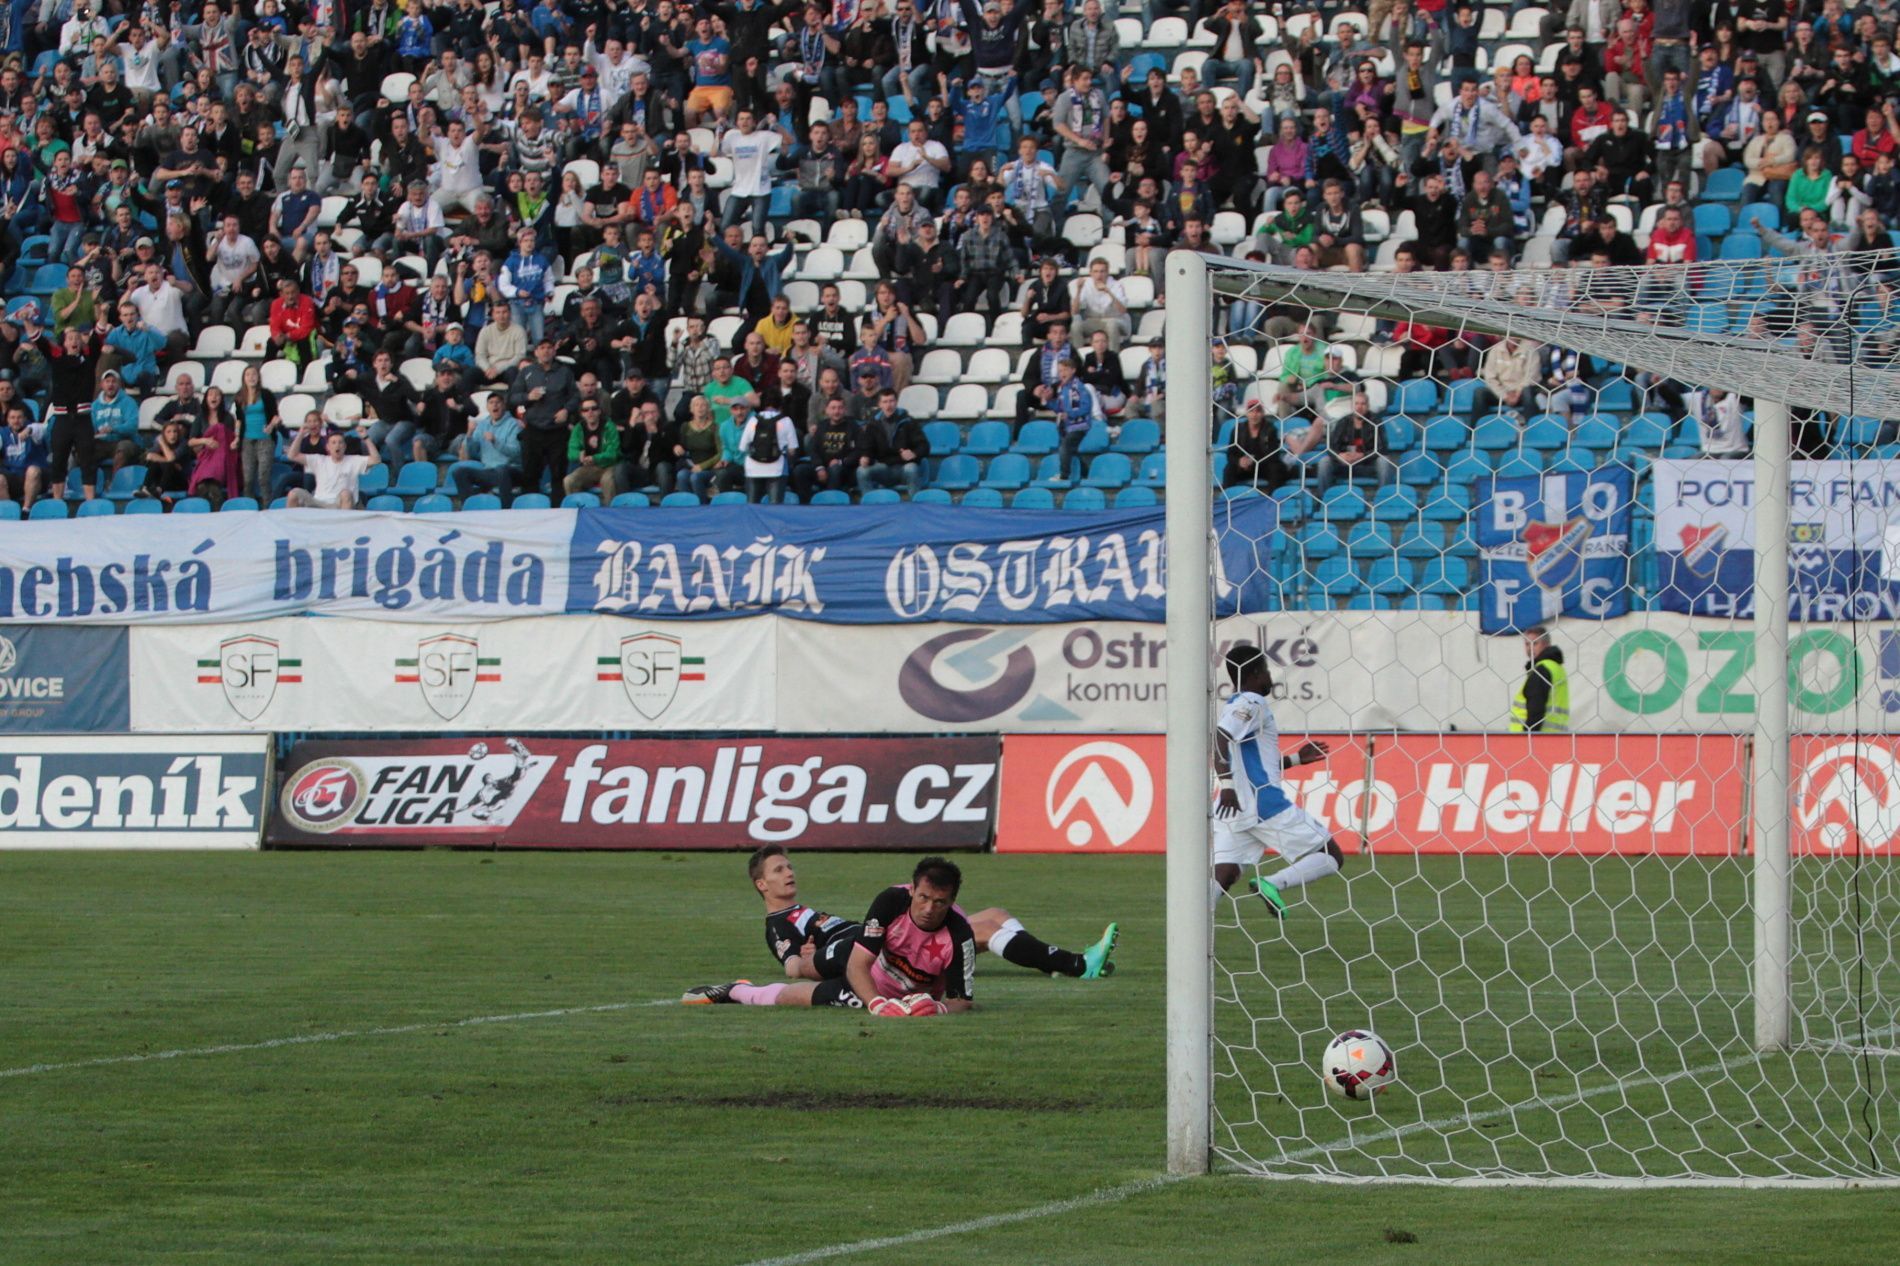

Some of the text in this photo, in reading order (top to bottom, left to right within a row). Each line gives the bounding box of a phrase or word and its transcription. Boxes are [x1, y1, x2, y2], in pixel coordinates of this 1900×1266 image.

[273, 529, 545, 609] brigáda
[226, 653, 275, 688] SF
[424, 652, 473, 687] SF
[626, 651, 675, 687] SF
[0, 755, 257, 828] deník
[370, 764, 475, 794] FAN
[561, 744, 996, 842] fanliga.cz
[354, 796, 458, 825] LIGA
[1416, 762, 1697, 834] Heller
